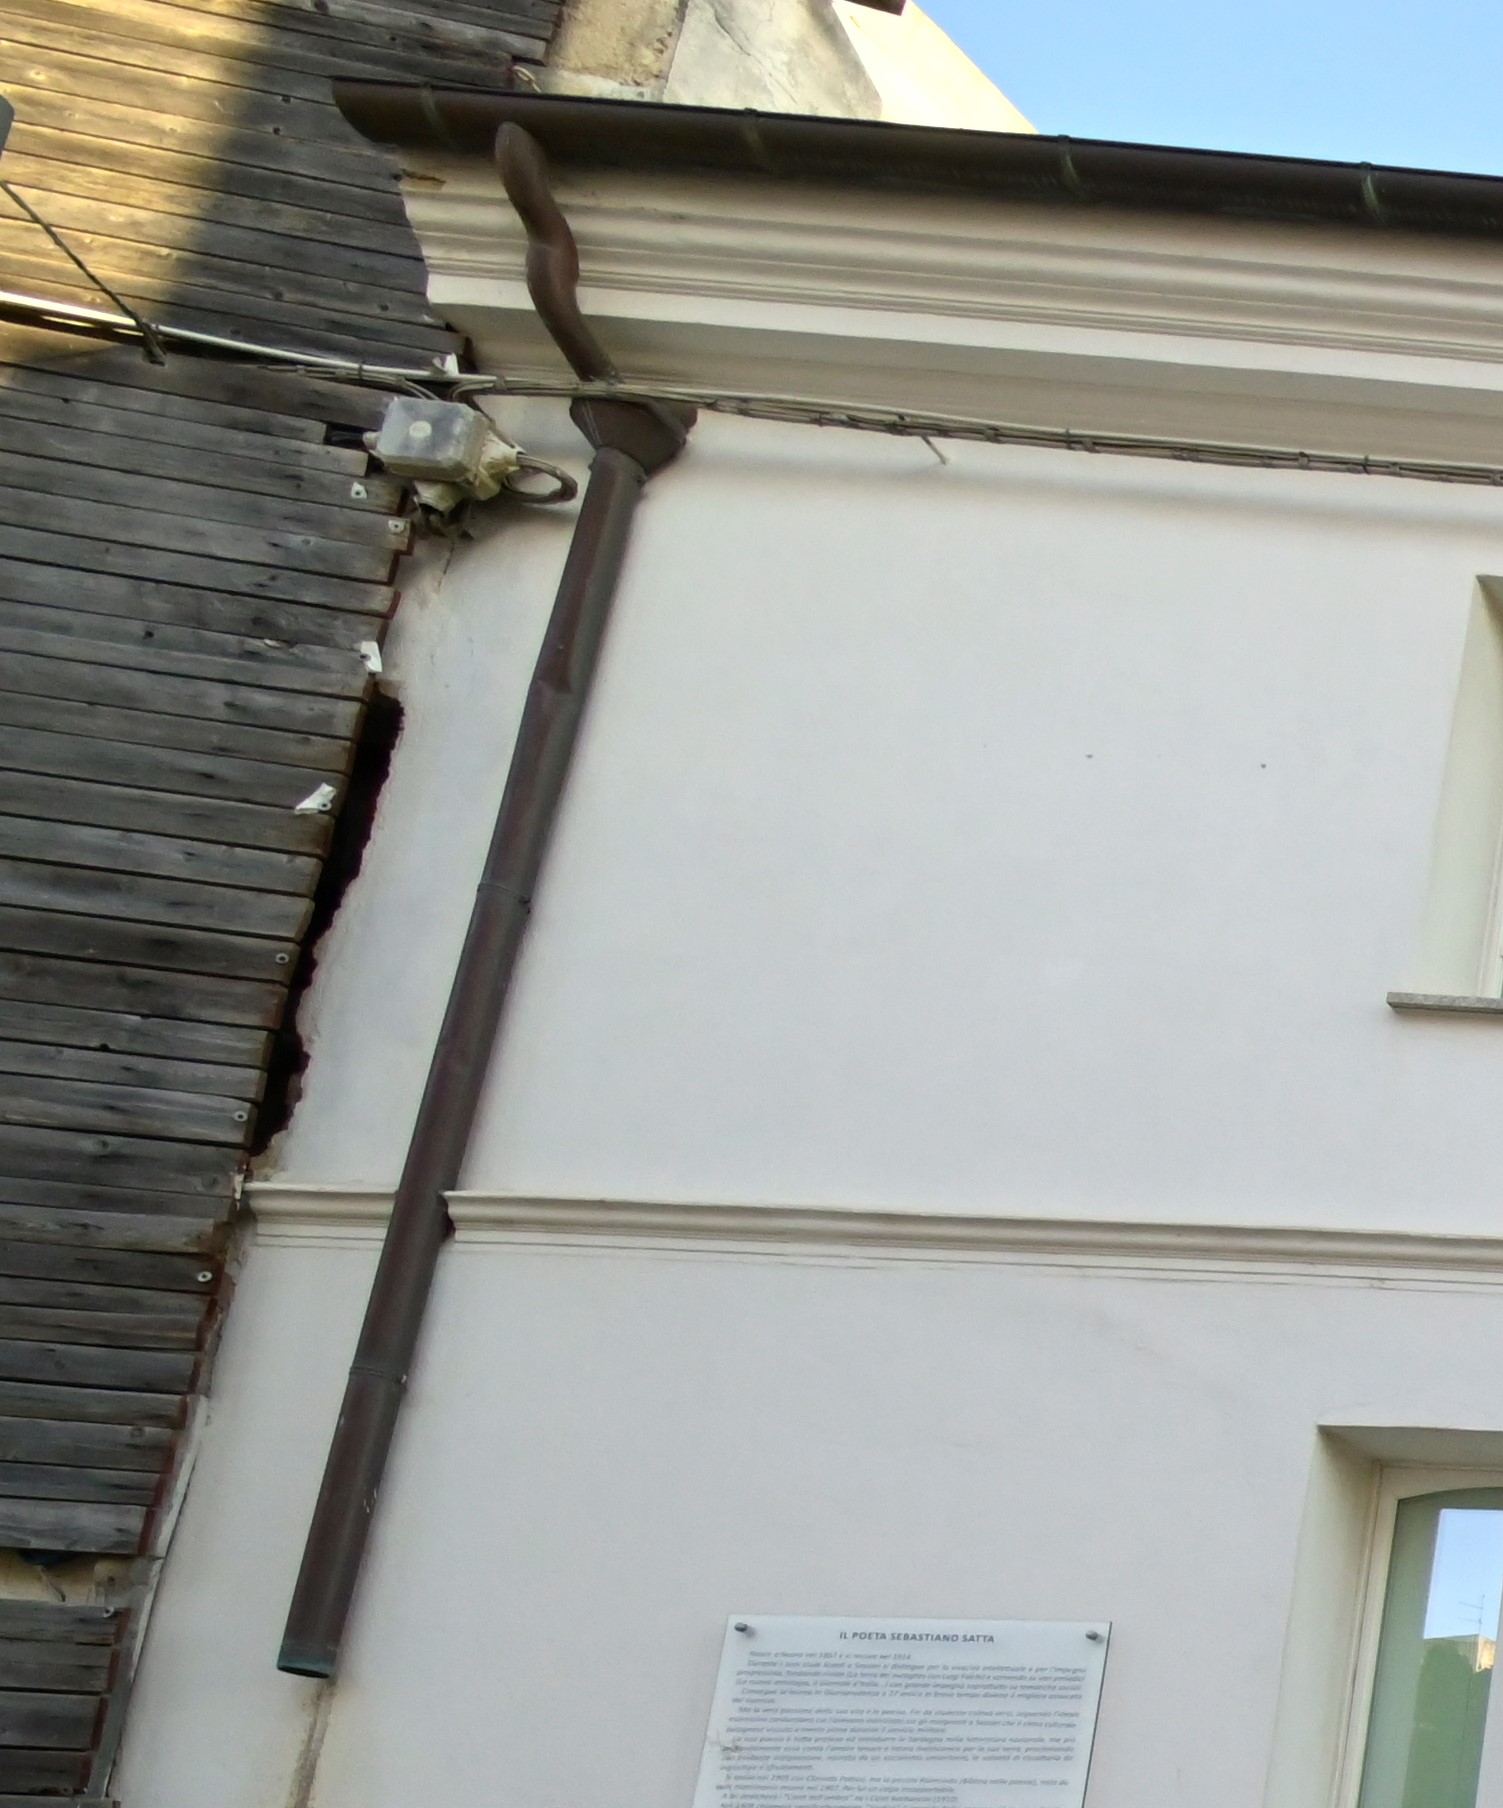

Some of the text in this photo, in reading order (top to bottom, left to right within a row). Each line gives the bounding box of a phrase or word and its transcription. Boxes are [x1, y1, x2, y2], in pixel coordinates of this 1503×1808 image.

[839, 1632, 995, 1643] IL POETA SEBASTIANO SATTA
